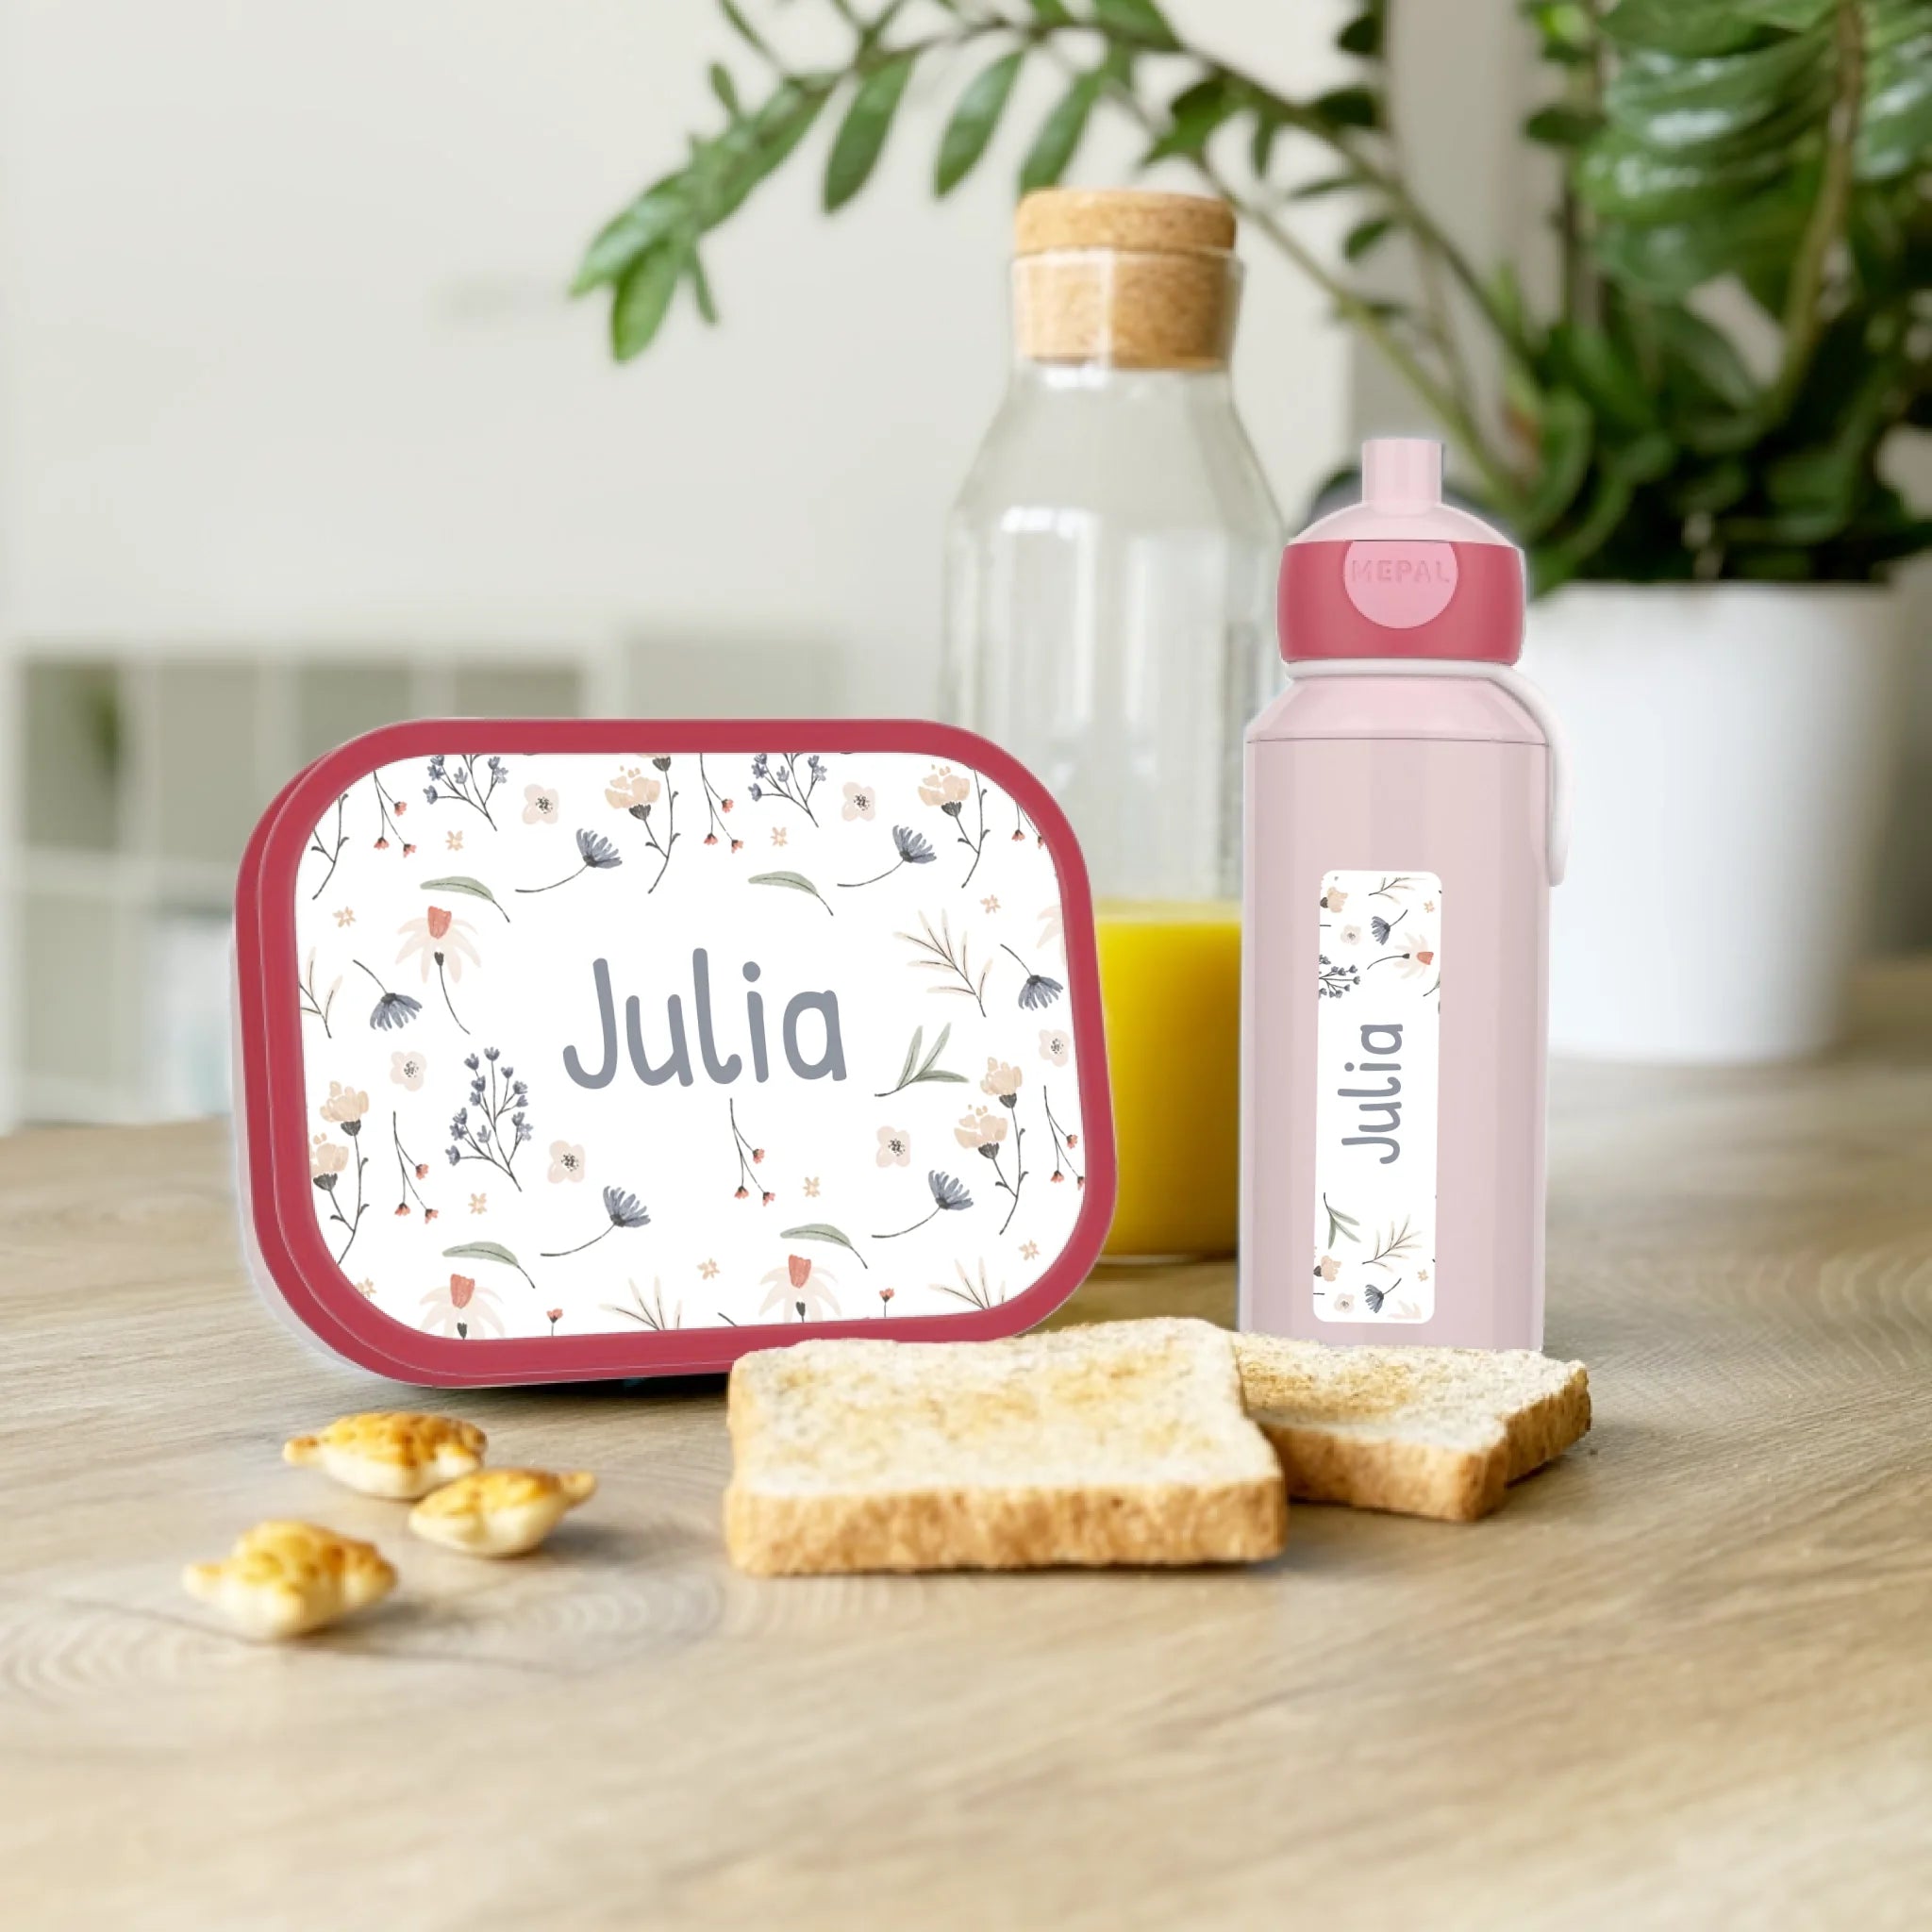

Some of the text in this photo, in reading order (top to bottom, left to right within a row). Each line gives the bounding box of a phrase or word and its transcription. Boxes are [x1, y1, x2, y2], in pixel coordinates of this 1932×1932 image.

[1351, 558, 1451, 583] MEPAL
[562, 947, 848, 1090] Julia
[1337, 1023, 1404, 1165] Julia
